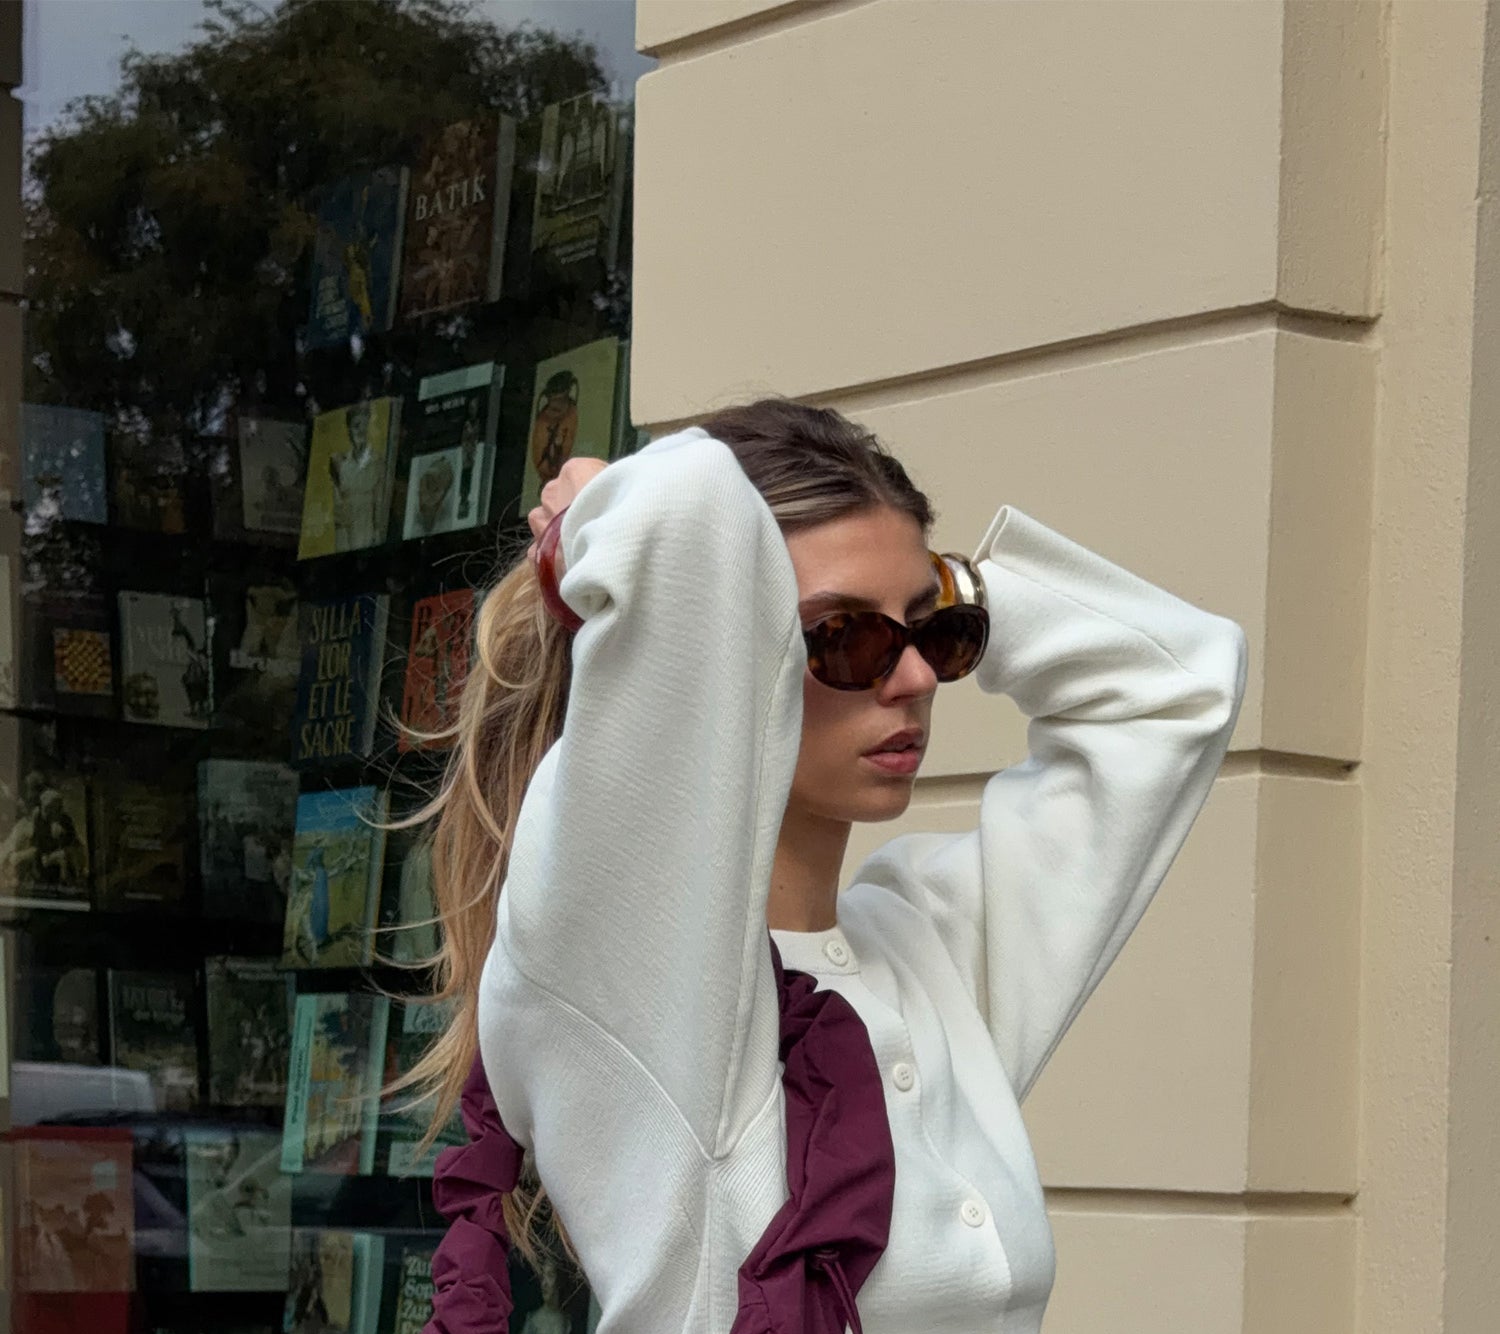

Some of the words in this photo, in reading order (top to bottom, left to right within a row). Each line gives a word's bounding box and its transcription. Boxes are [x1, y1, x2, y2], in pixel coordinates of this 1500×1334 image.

[415, 175, 486, 221] BATIK
[310, 600, 362, 645] SILLA
[308, 682, 333, 720] ET
[334, 679, 353, 716] LE
